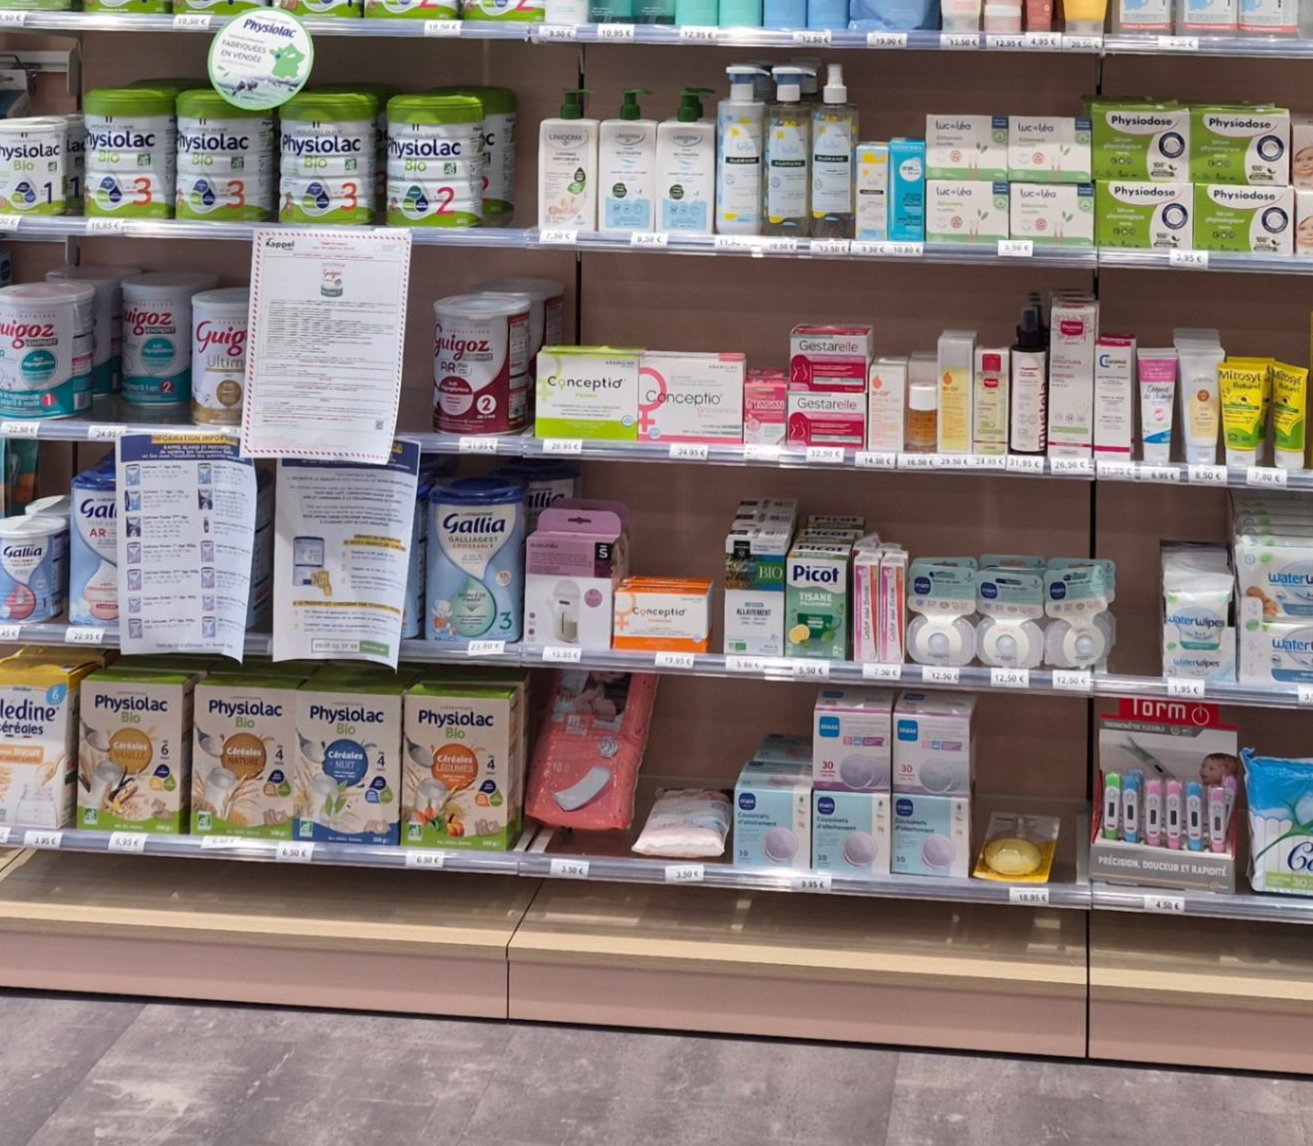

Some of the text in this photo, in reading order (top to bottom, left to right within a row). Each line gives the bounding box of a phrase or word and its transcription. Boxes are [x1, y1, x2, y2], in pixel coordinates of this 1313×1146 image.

[243, 17, 297, 40] Physiolac
[221, 49, 231, 58] EN
[1111, 115, 1173, 127] Physiodose
[1208, 117, 1272, 130] Physiodose
[282, 134, 361, 155] Physiolac
[132, 177, 152, 207] 3
[340, 182, 358, 211] 3
[1213, 189, 1276, 202] Physiodose
[436, 187, 455, 216] 2
[799, 339, 860, 353] Gestarelle
[1219, 370, 1262, 382] Mitosyl
[481, 397, 491, 413] 2
[645, 389, 721, 406] Conceptio
[797, 397, 858, 411] Gestarelle
[1038, 382, 1049, 452] mustela
[442, 513, 506, 534] Gallia
[3, 545, 43, 558] Gallia
[758, 564, 783, 580] BIO
[792, 564, 840, 585] Picot
[799, 592, 833, 603] TISANE
[498, 611, 512, 630] 3
[95, 694, 168, 713] Physiolac
[208, 698, 283, 718] Physiolac
[121, 712, 141, 724] Bio
[310, 705, 385, 725] Physiolac
[418, 709, 494, 728] Physiolac
[113, 740, 148, 751] Céréales
[227, 756, 259, 766] NATURE
[334, 760, 356, 770] NUIT
[1142, 860, 1180, 873] DOUCEUR
[1180, 862, 1190, 873] ET
[1191, 863, 1227, 877] RAPIDITÉ
